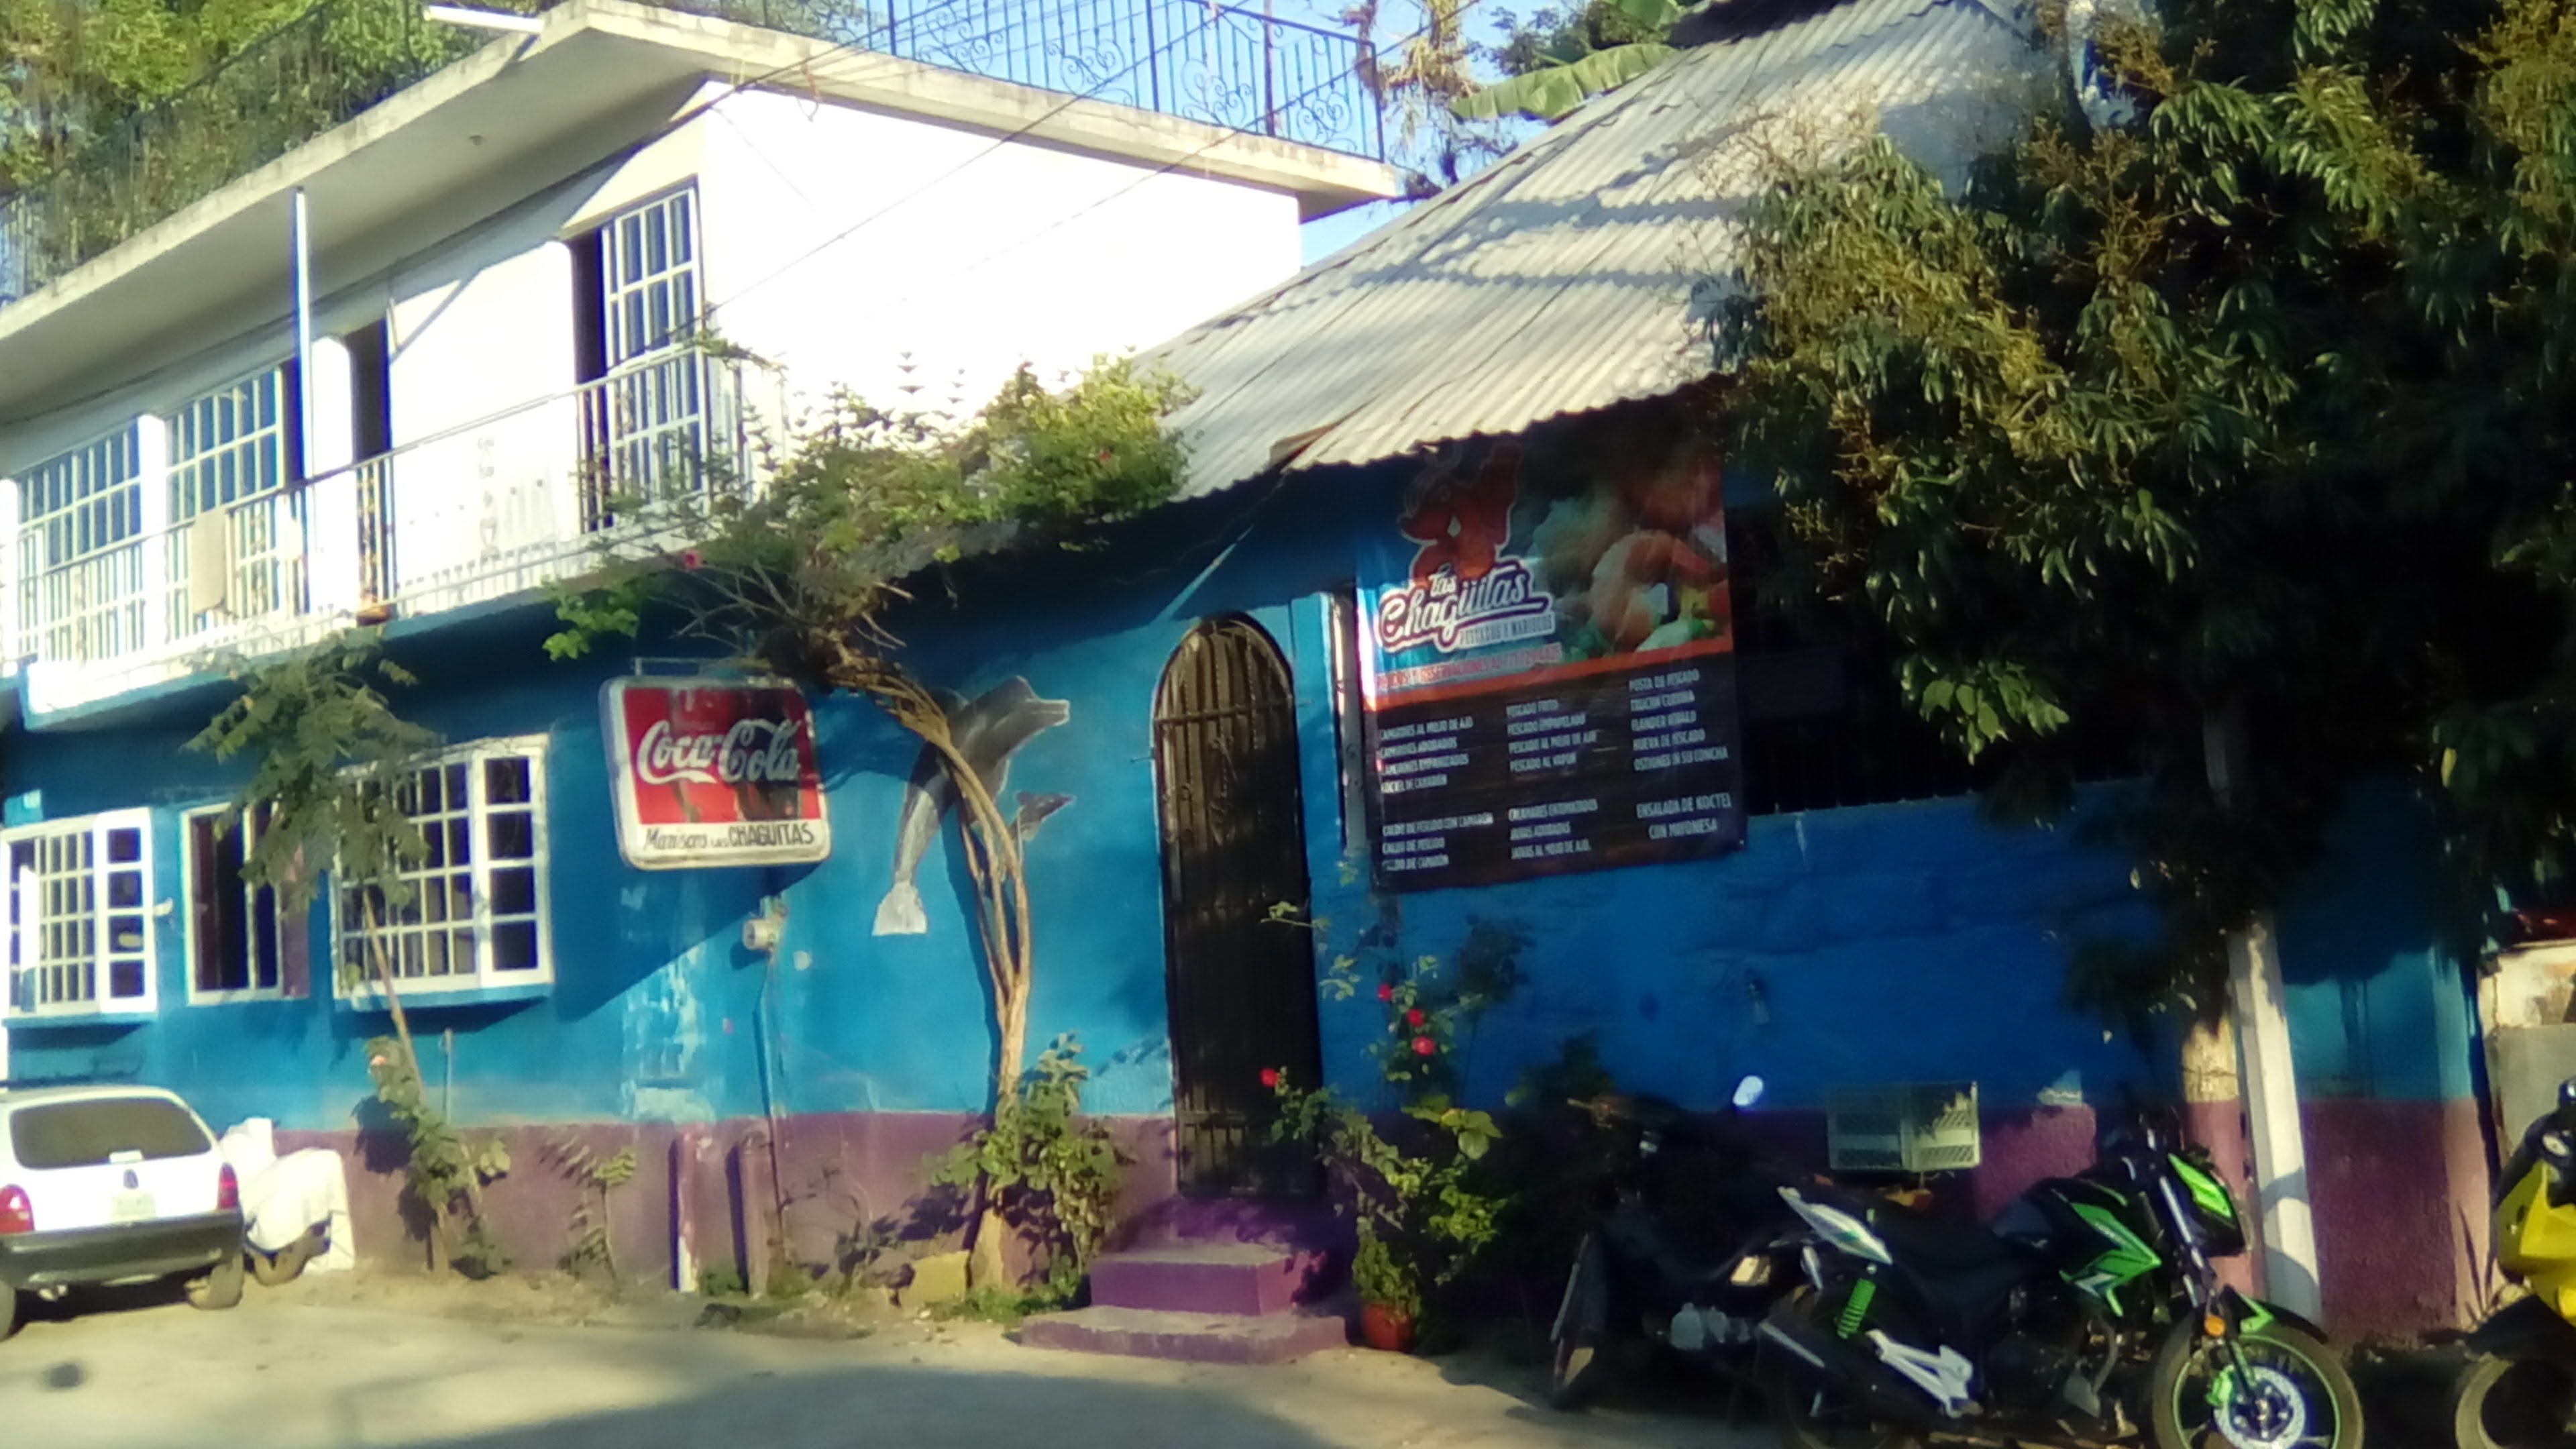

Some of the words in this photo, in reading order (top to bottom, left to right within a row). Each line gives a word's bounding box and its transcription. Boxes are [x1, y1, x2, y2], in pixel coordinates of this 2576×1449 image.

[638, 719, 802, 784] Coca-Cola
[1637, 800, 1680, 818] ENSALADA
[1681, 797, 1694, 812] DE
[1649, 824, 1667, 839] CON
